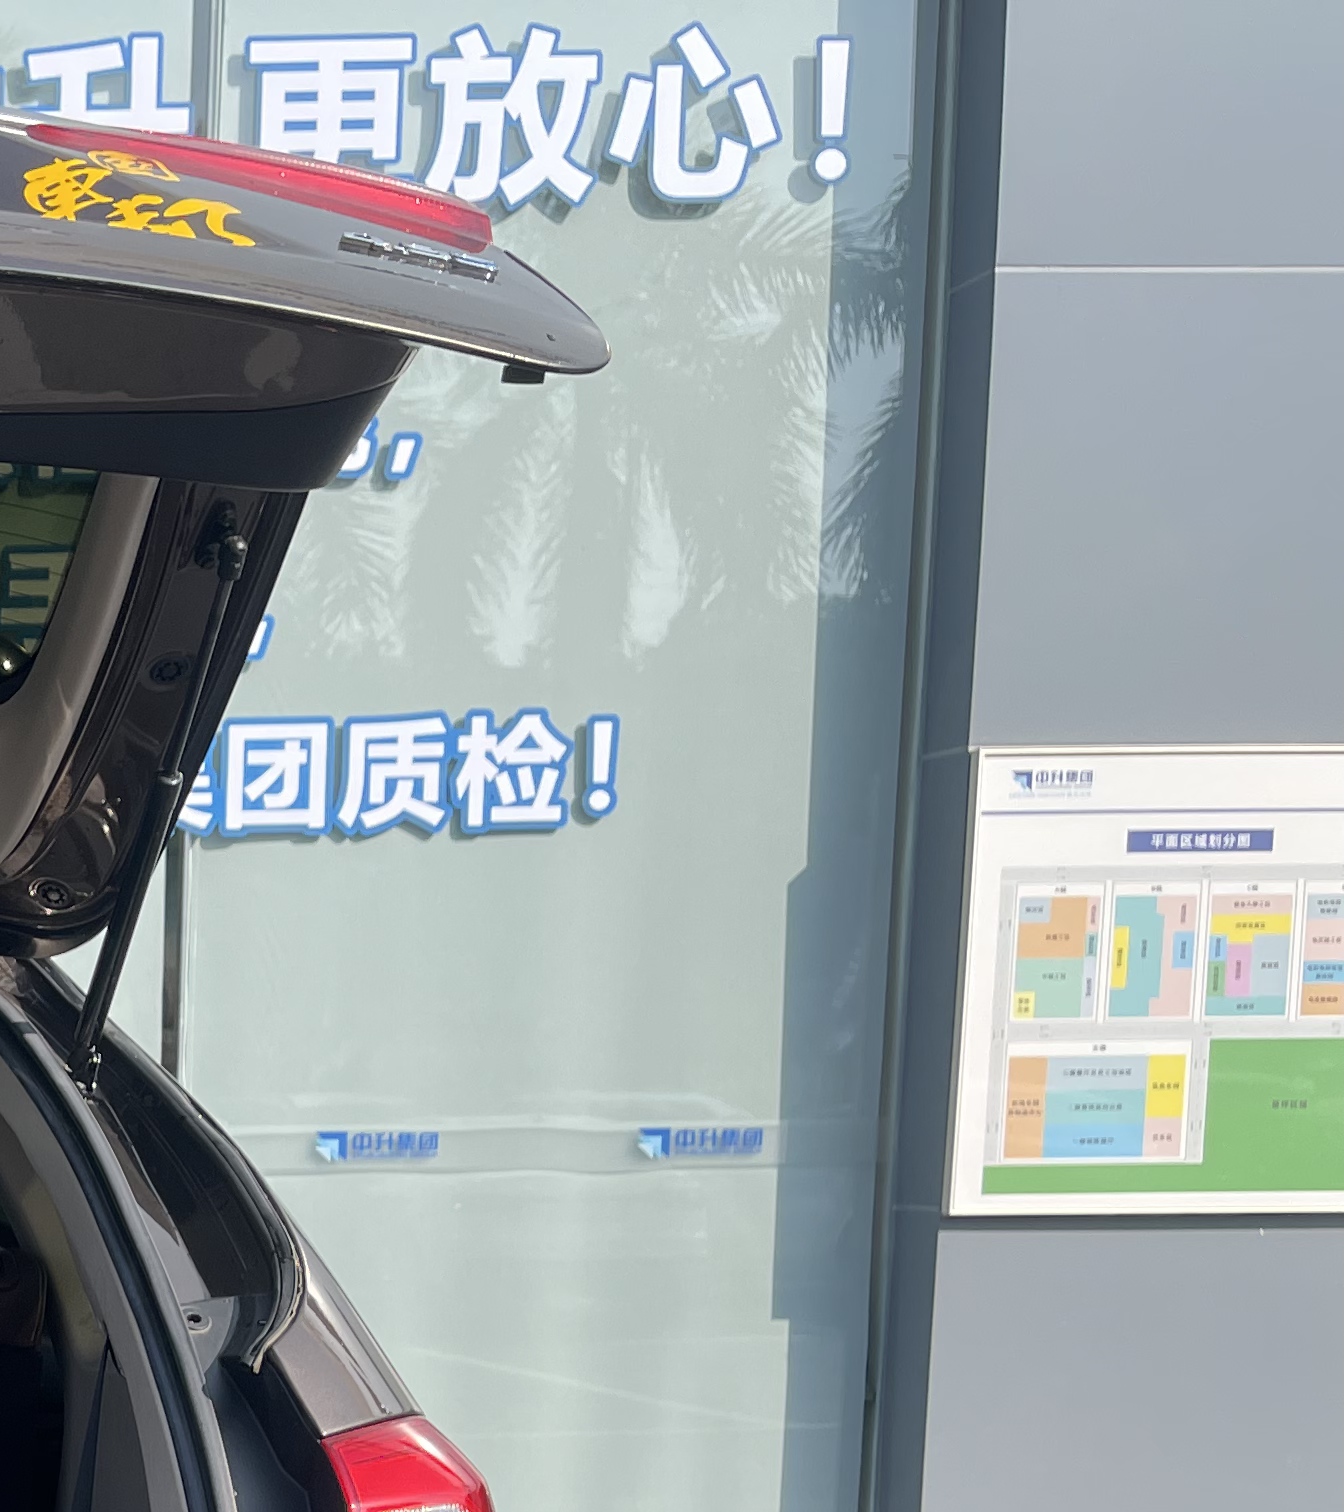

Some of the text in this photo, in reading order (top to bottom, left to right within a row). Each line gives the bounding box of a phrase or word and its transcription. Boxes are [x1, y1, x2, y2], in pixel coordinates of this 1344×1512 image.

[245, 19, 853, 208] 更放心！
[353, 1131, 439, 1151] 中升集团
[675, 1127, 763, 1147] 中升集团
